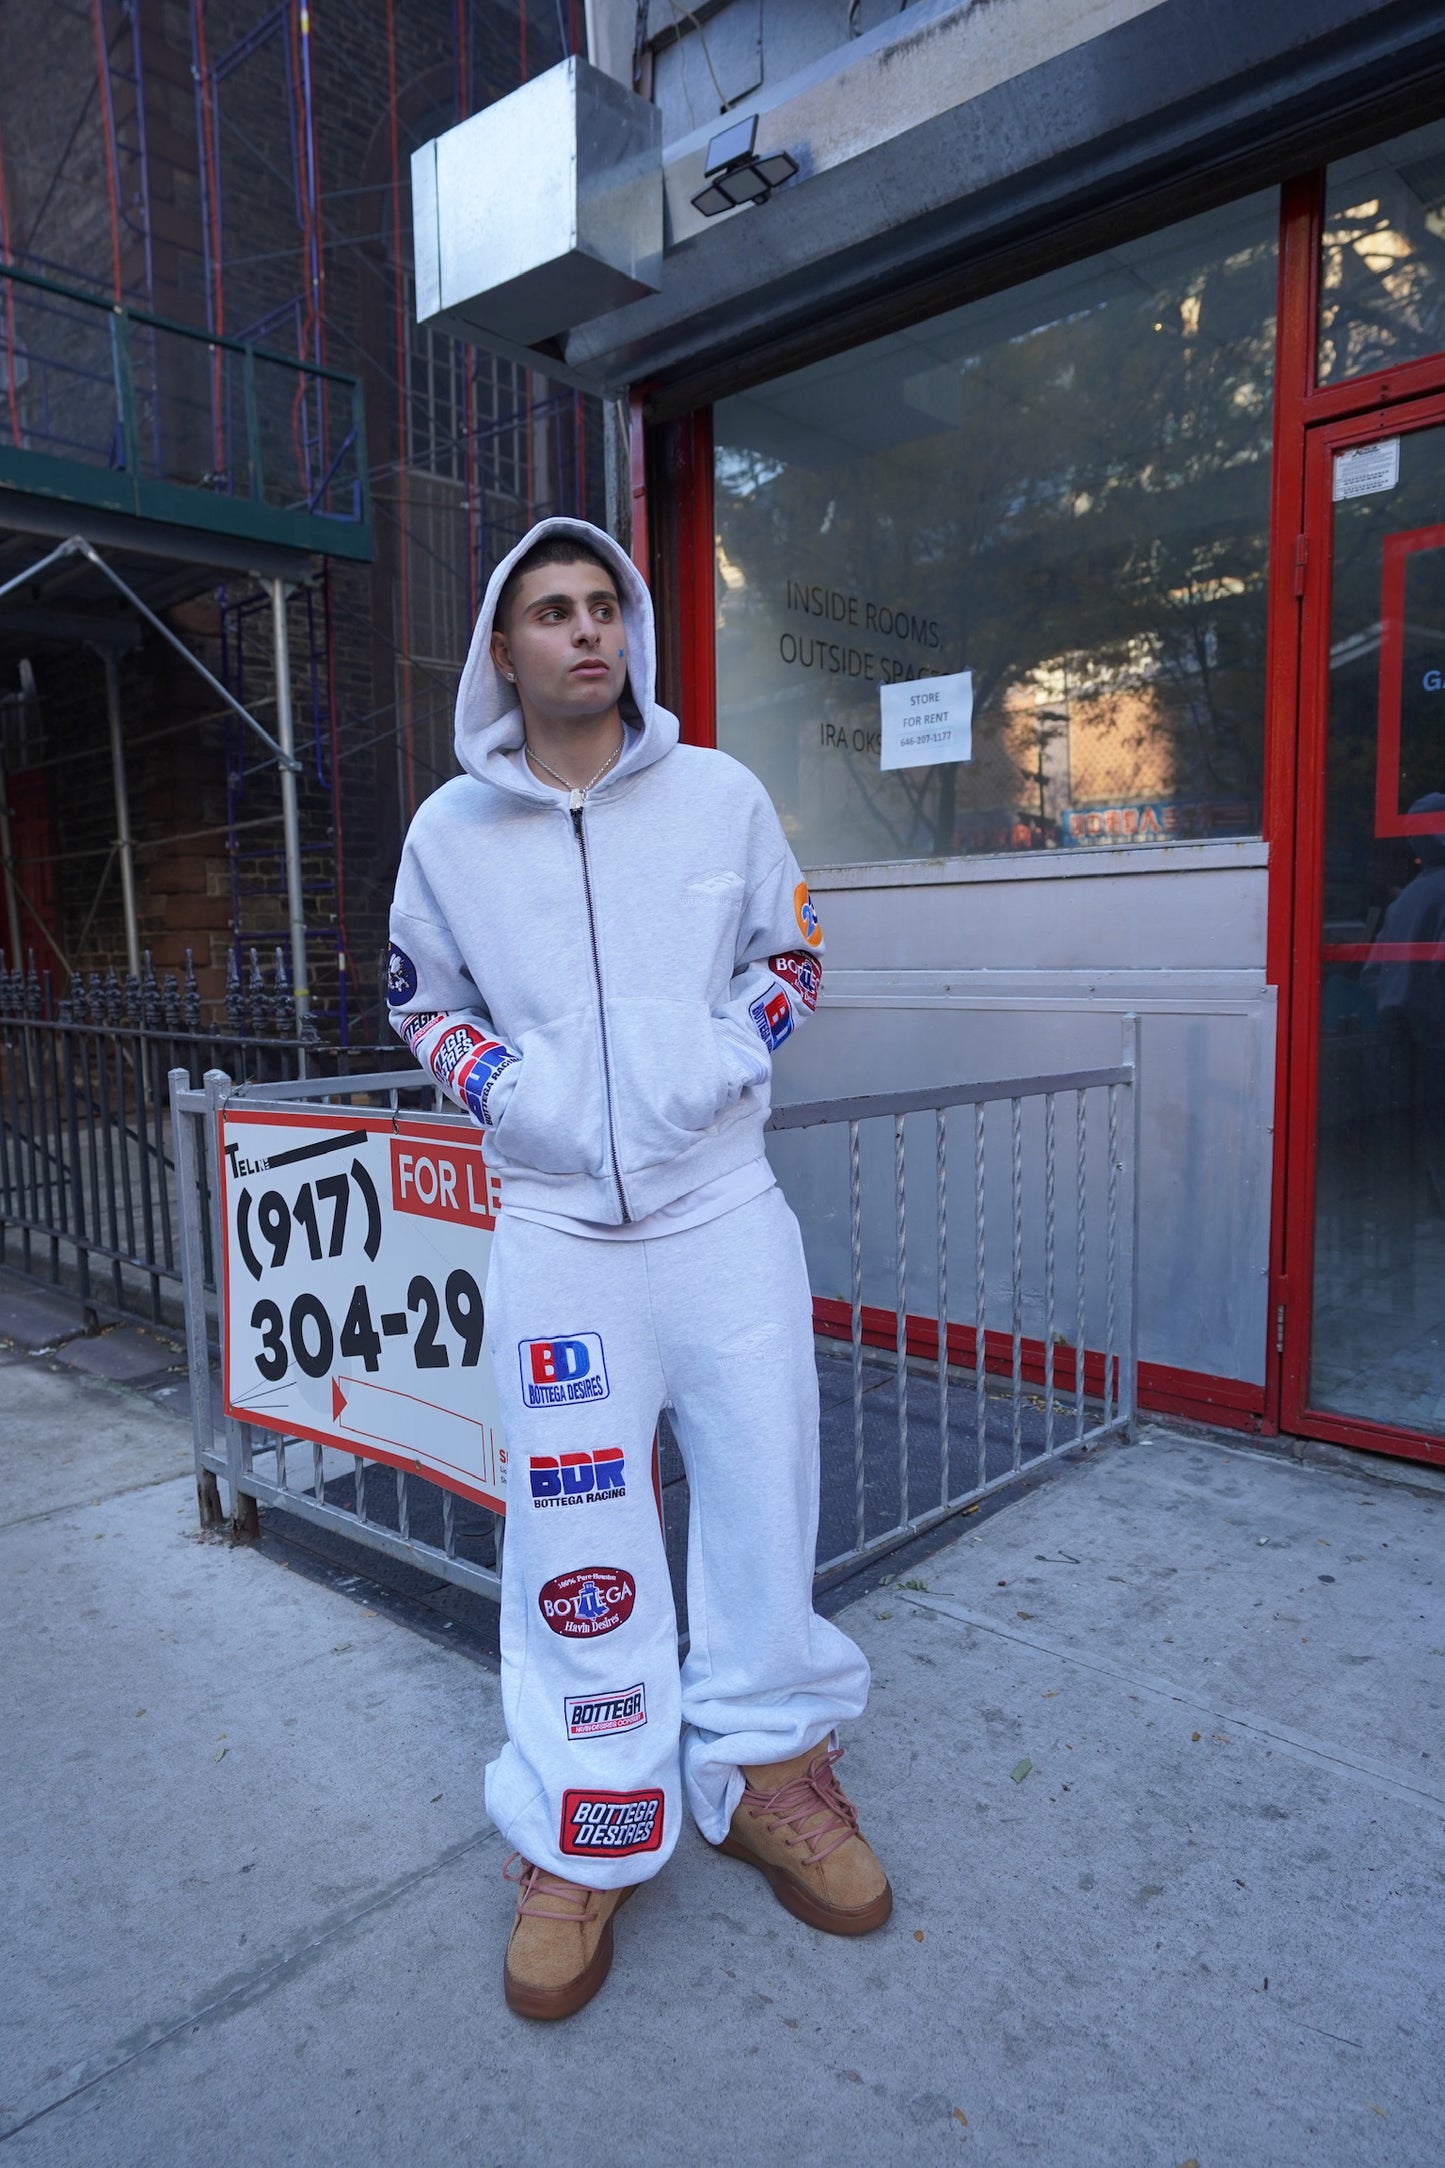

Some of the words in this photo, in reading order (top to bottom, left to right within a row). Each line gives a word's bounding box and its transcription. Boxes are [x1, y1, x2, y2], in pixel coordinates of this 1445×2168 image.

[786, 579, 858, 626] INSIDE
[780, 633, 875, 682] OUTSIDE
[910, 692, 940, 706] STORE
[903, 716, 921, 728] FOR
[924, 711, 949, 724] RENT
[820, 723, 848, 749] IRA
[399, 1153, 459, 1210] FOR
[237, 1158, 382, 1282] (917)
[250, 1268, 485, 1381] 304-29
[530, 1340, 590, 1384] BD
[528, 1384, 566, 1405] BOTTEGA
[568, 1375, 603, 1400] DESIRES
[530, 1447, 626, 1498] BDR
[534, 1494, 583, 1509] BOTTEGA
[586, 1487, 626, 1503] RACING
[543, 1581, 632, 1617] BOTTEGA
[564, 1621, 590, 1633] Havin
[592, 1613, 620, 1632] Desires
[571, 1693, 642, 1725] BOTTEGA
[573, 1799, 659, 1825] BOTTEGA
[574, 1821, 654, 1847] DESIRES
